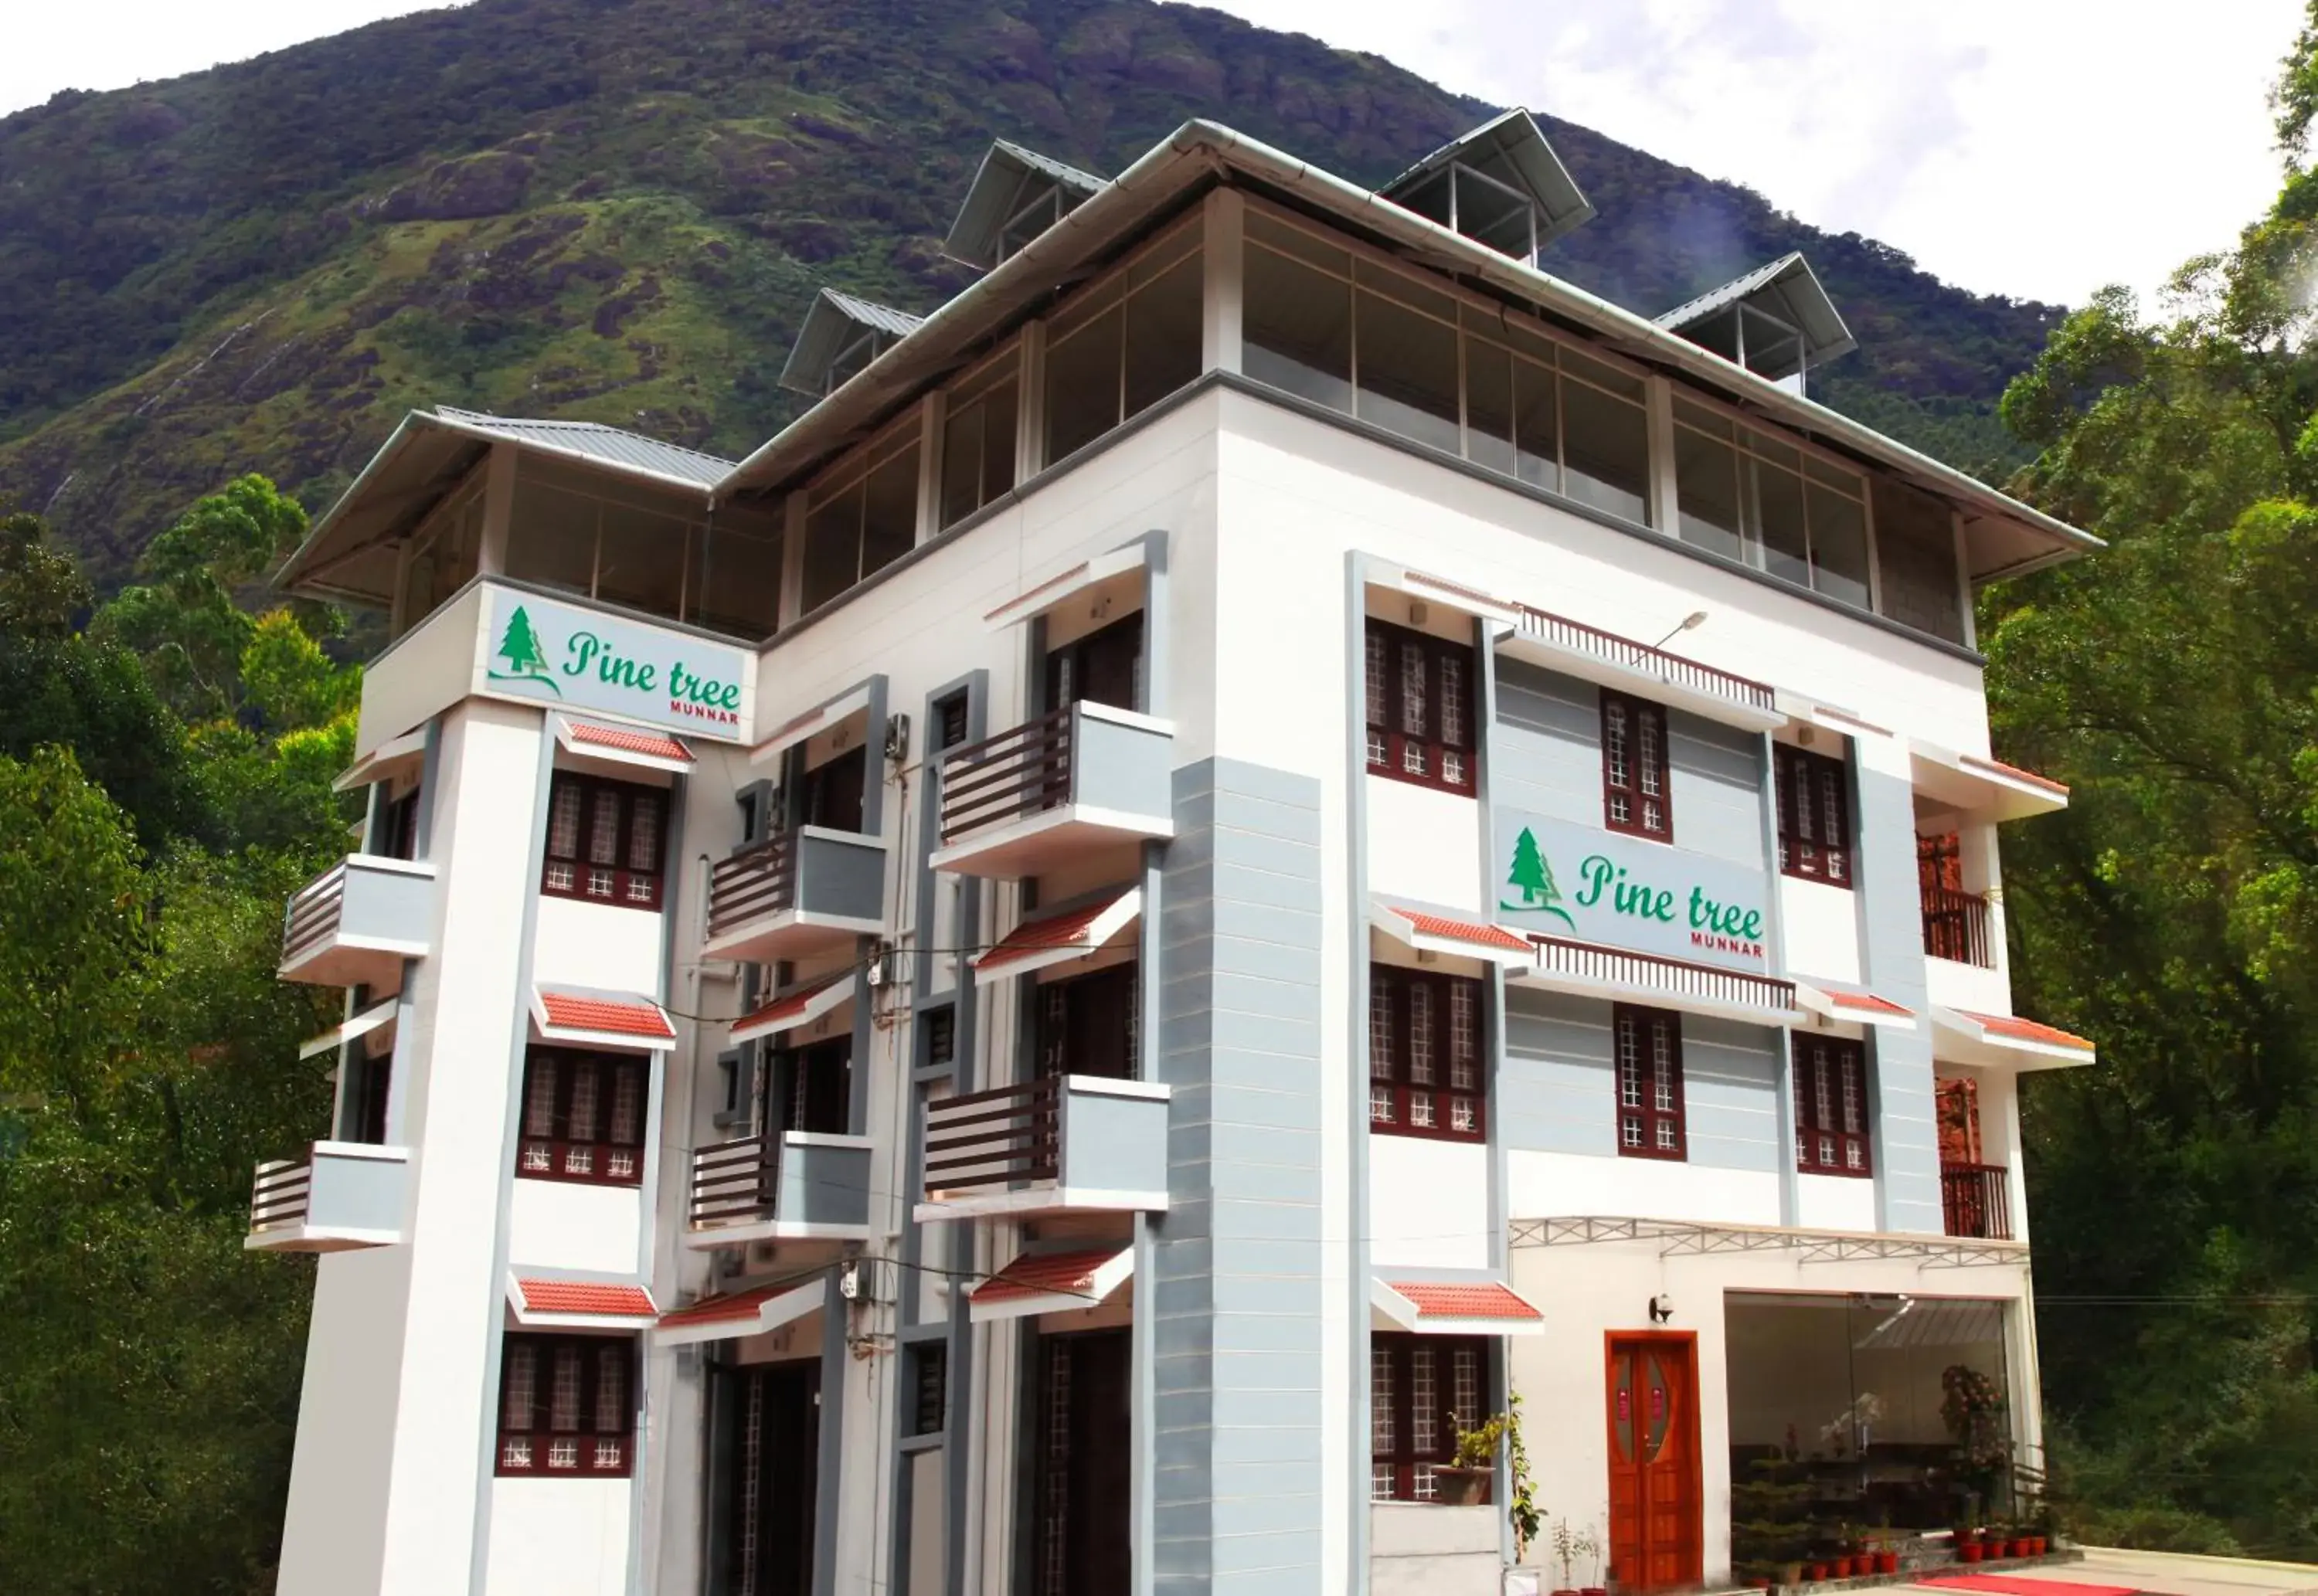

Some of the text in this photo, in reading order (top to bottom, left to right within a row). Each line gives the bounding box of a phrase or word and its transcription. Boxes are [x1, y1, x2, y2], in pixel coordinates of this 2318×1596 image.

[563, 631, 739, 709] Pine tree
[670, 701, 739, 725] MUNNAR
[1575, 855, 1762, 940] Pine tree
[1690, 932, 1763, 958] MUNNAR
